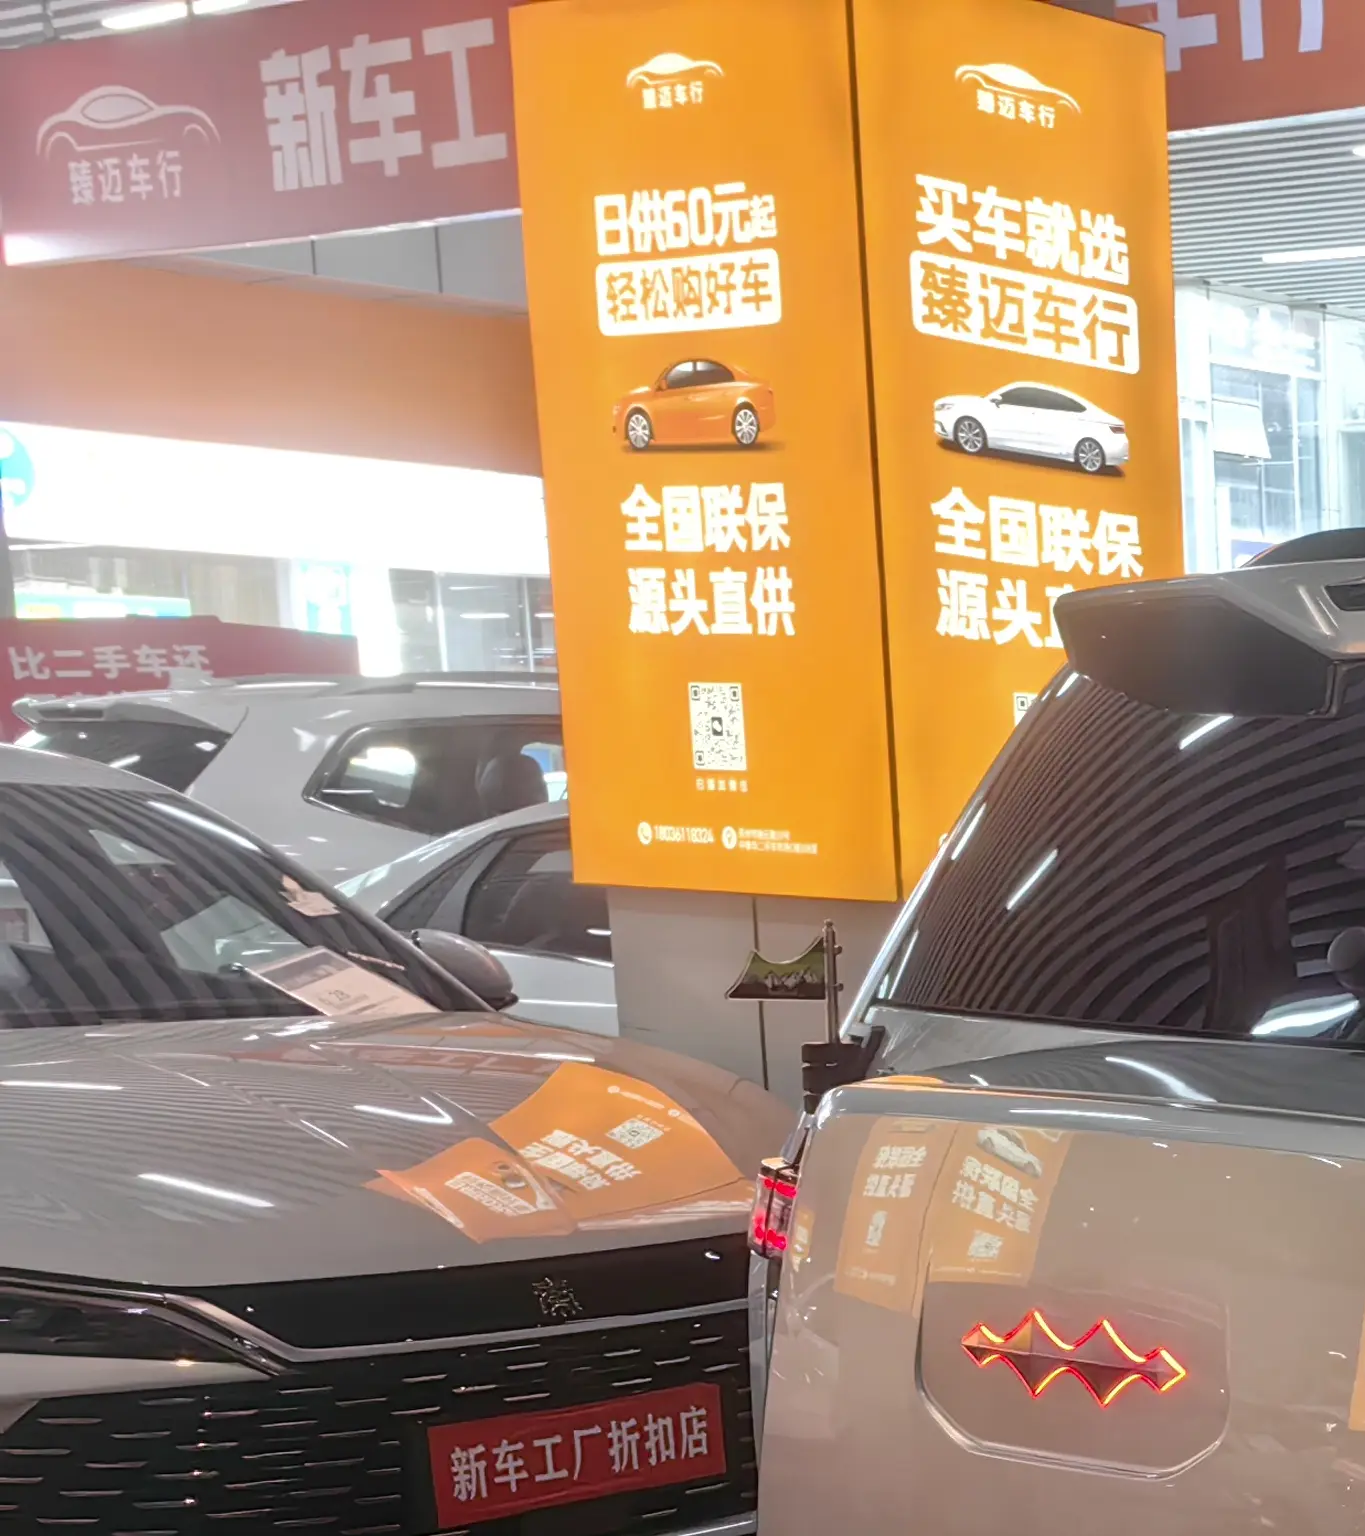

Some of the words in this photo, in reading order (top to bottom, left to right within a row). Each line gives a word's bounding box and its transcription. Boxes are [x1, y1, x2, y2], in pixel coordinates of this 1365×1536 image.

[68, 151, 183, 206] 臻迈车行
[915, 174, 1129, 285] 买车就选
[604, 258, 774, 323] 轻松购好车
[920, 260, 1136, 367] 臻迈车行
[620, 482, 791, 553] 全国联保
[930, 486, 1144, 578] 全国联保
[627, 566, 796, 637] 源头直供
[450, 1404, 709, 1503] 新车工厂折扣店
